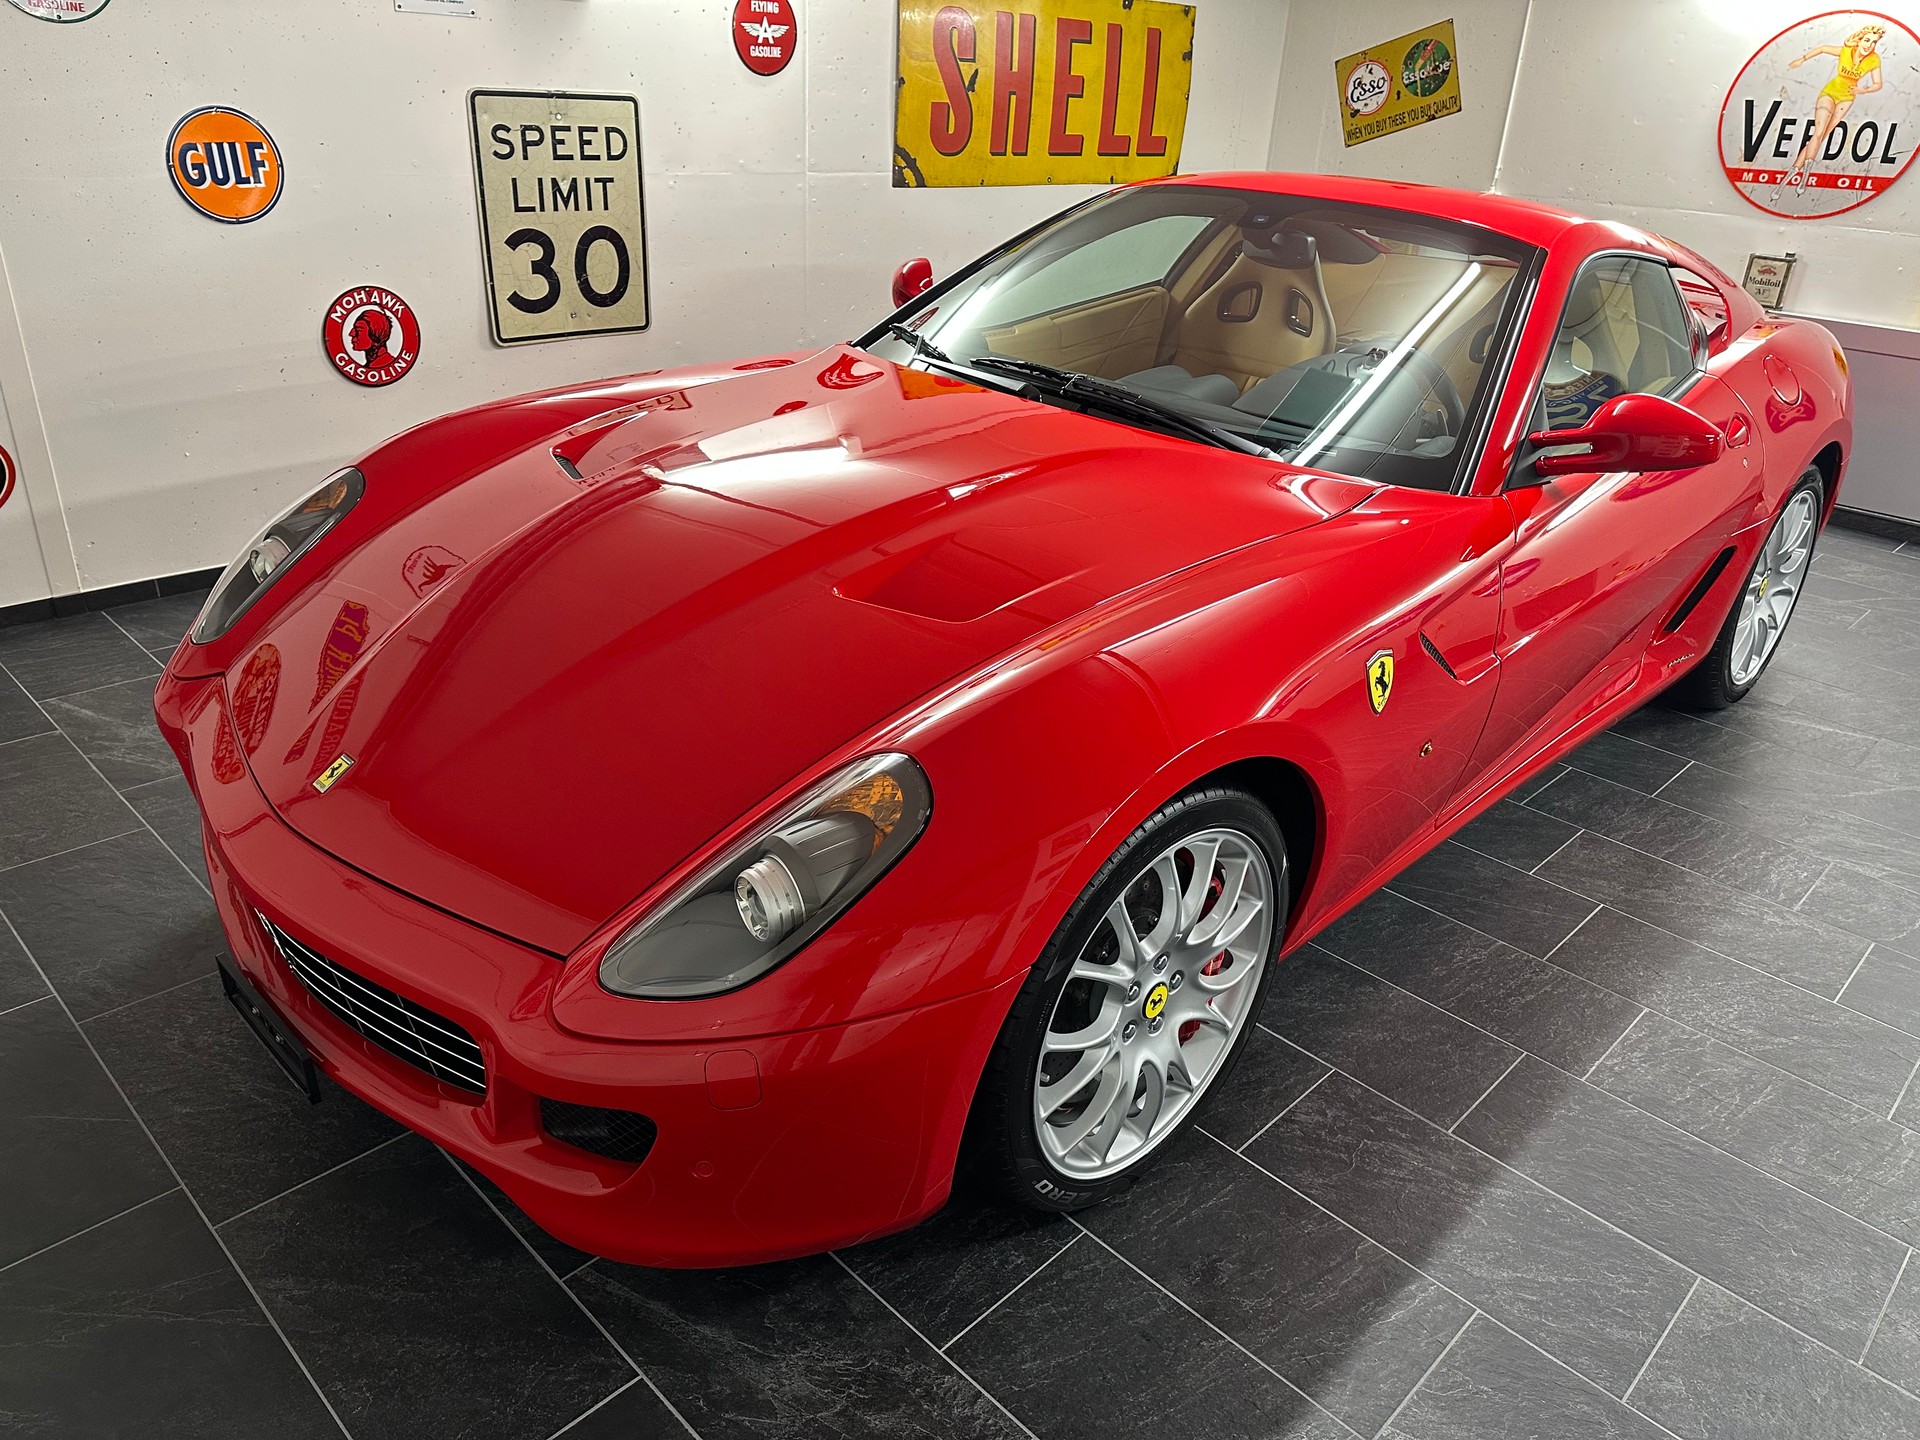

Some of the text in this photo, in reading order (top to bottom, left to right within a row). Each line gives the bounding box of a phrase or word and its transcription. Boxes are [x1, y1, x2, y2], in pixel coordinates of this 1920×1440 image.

[750, 0, 779, 14] FLYING
[750, 45, 781, 58] GASOLINE
[929, 6, 1168, 157] SHELL
[1403, 60, 1450, 84] Essolbe
[1351, 76, 1388, 103] Esso
[1345, 95, 1458, 141] WHEN YOU BUY THESE YOU BUY QUALITY
[491, 123, 628, 161] SPEED
[178, 141, 270, 189] GULF
[1742, 171, 1874, 190] MOTOR OIL
[511, 176, 615, 213] LIMIT
[504, 224, 630, 315] 30
[1748, 276, 1781, 288] Mobiloil
[330, 290, 404, 323] MOHAWK
[335, 350, 413, 382] GASOLINE
